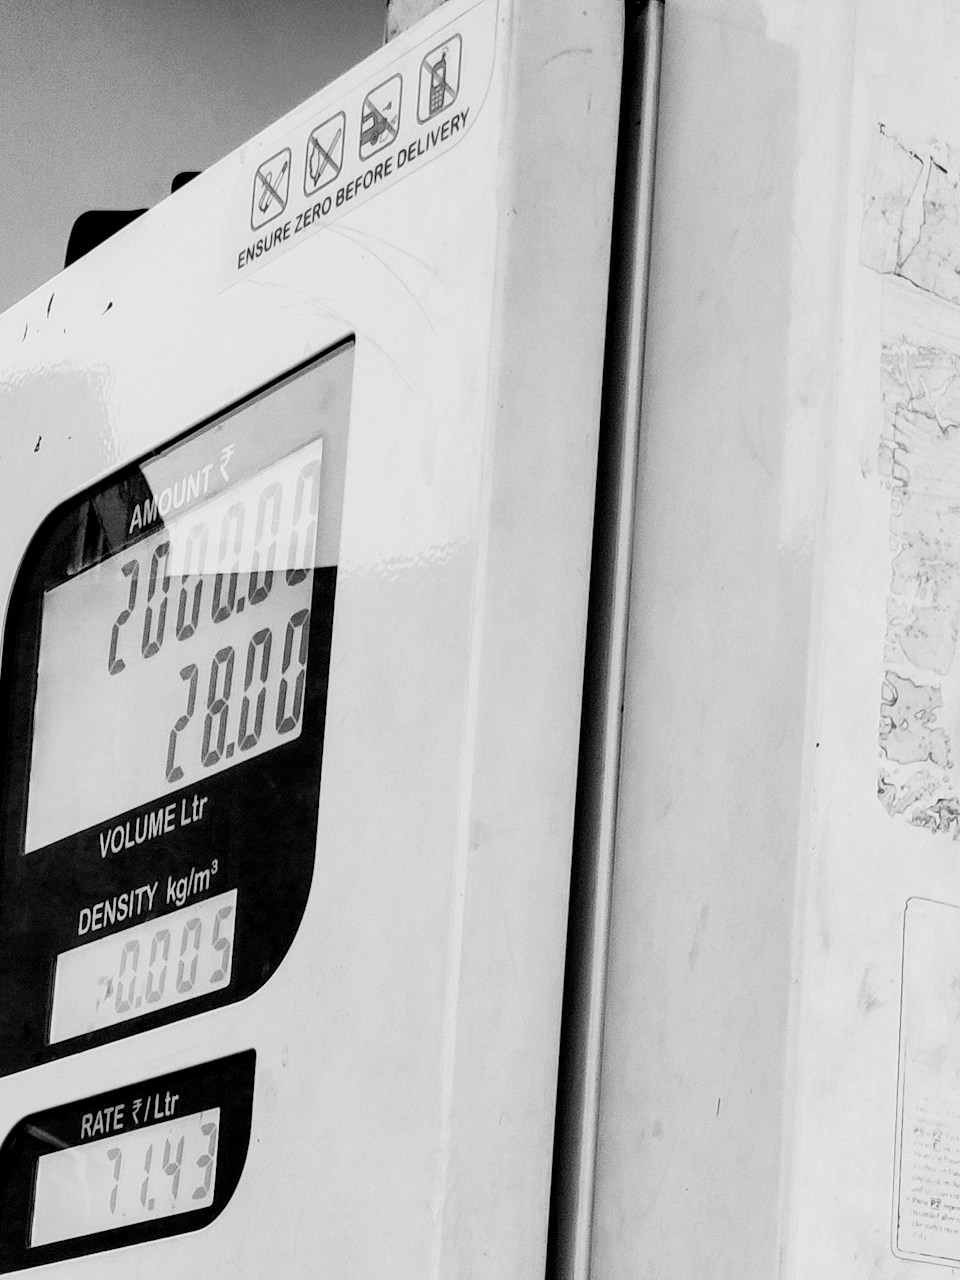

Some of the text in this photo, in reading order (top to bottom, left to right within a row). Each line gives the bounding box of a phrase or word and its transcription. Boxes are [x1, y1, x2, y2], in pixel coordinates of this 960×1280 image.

[238, 107, 470, 270] ENSURE ZERO BEFORE DELIVERY
[129, 463, 214, 535] AMOUNT
[166, 608, 310, 783] 28.00
[99, 794, 208, 858] VOLUME Ltr
[78, 881, 158, 936] DENSITY
[81, 1104, 124, 1139] RATE
[106, 1122, 216, 1215] 71.43
